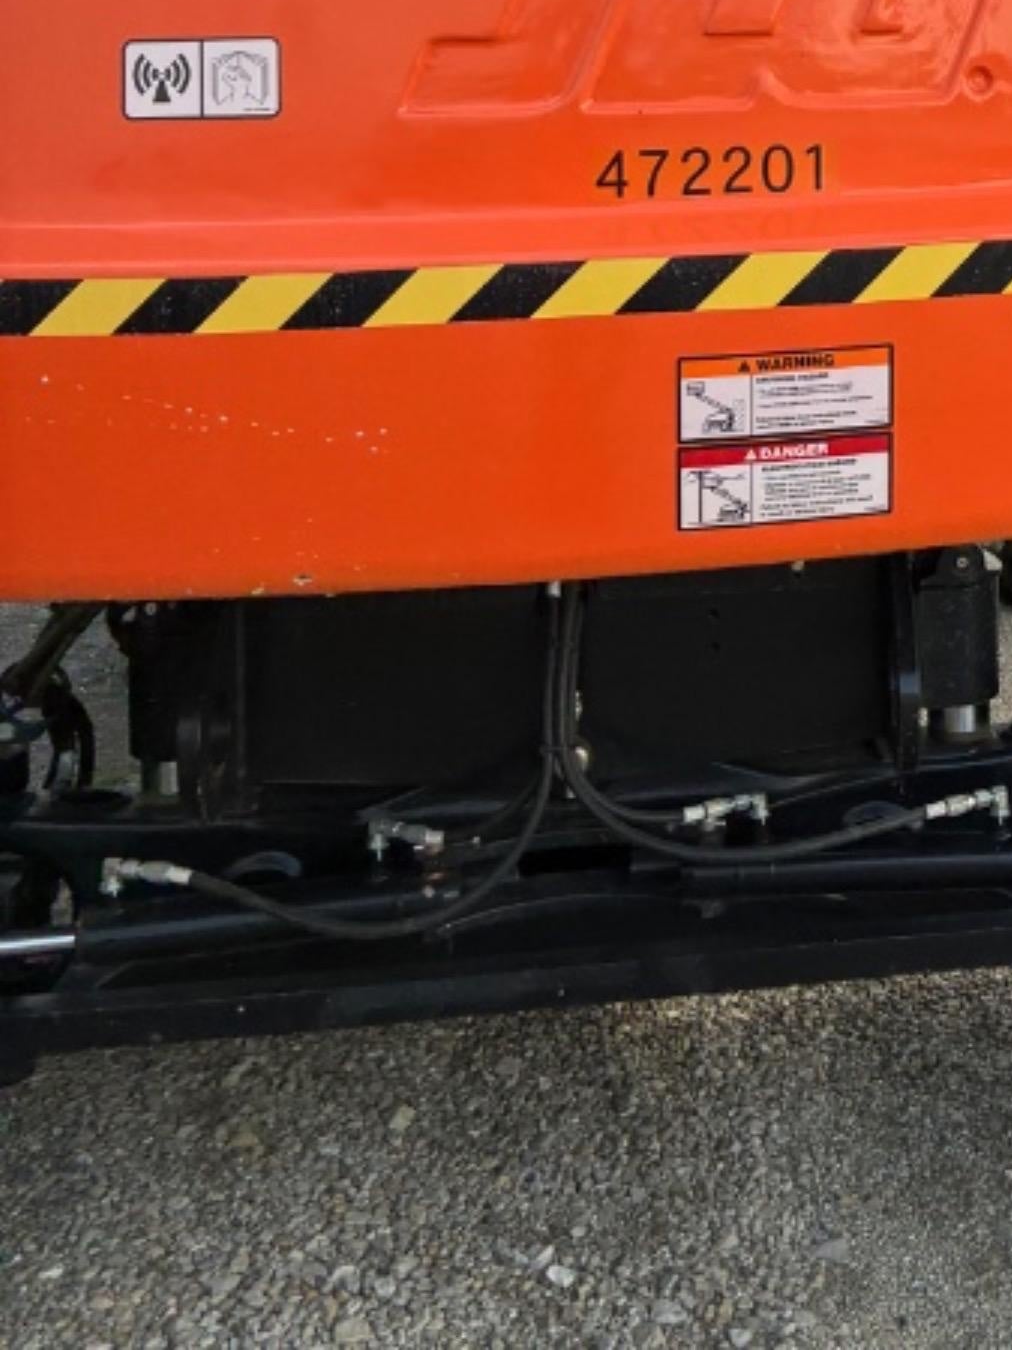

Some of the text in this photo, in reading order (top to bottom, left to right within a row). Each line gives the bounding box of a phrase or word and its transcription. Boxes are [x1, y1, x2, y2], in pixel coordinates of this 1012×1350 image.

[595, 144, 825, 199] 472201
[755, 353, 835, 372] WARNING
[761, 442, 829, 460] DANGER
